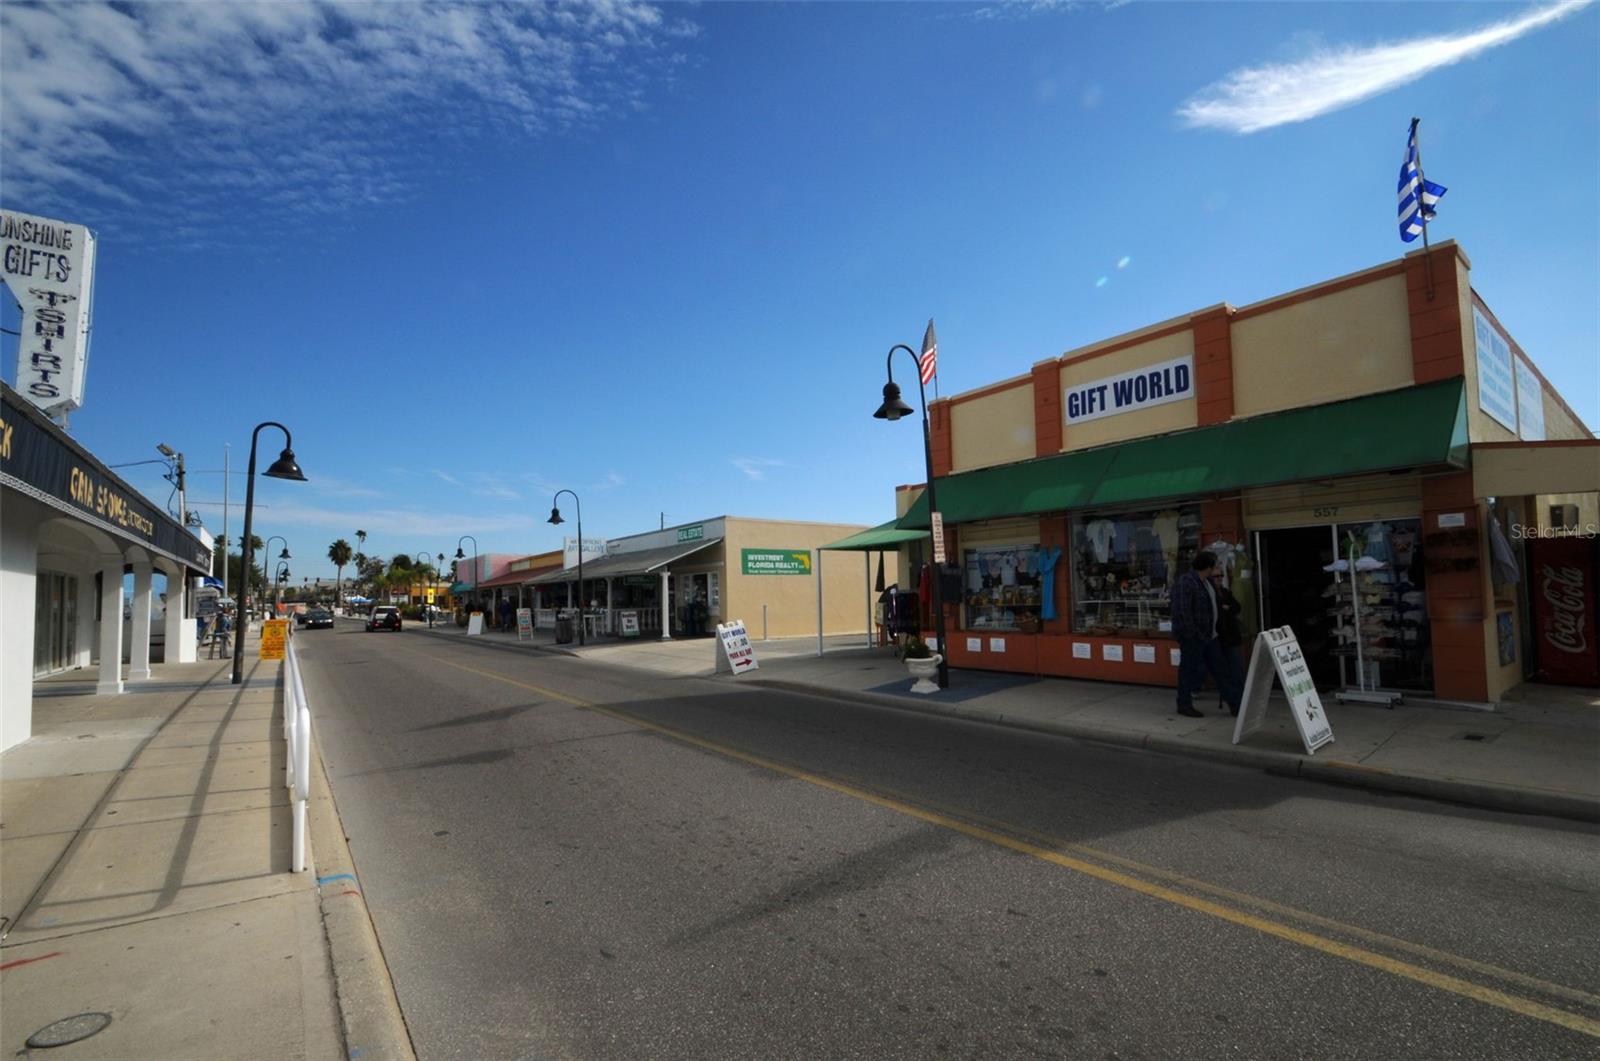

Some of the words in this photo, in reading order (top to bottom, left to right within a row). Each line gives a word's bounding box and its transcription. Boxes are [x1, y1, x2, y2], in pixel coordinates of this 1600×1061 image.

[4, 244, 72, 283] GIFTS
[1068, 385, 1108, 418] GIFT
[1113, 364, 1190, 408] WORLD
[1313, 506, 1339, 518] 557
